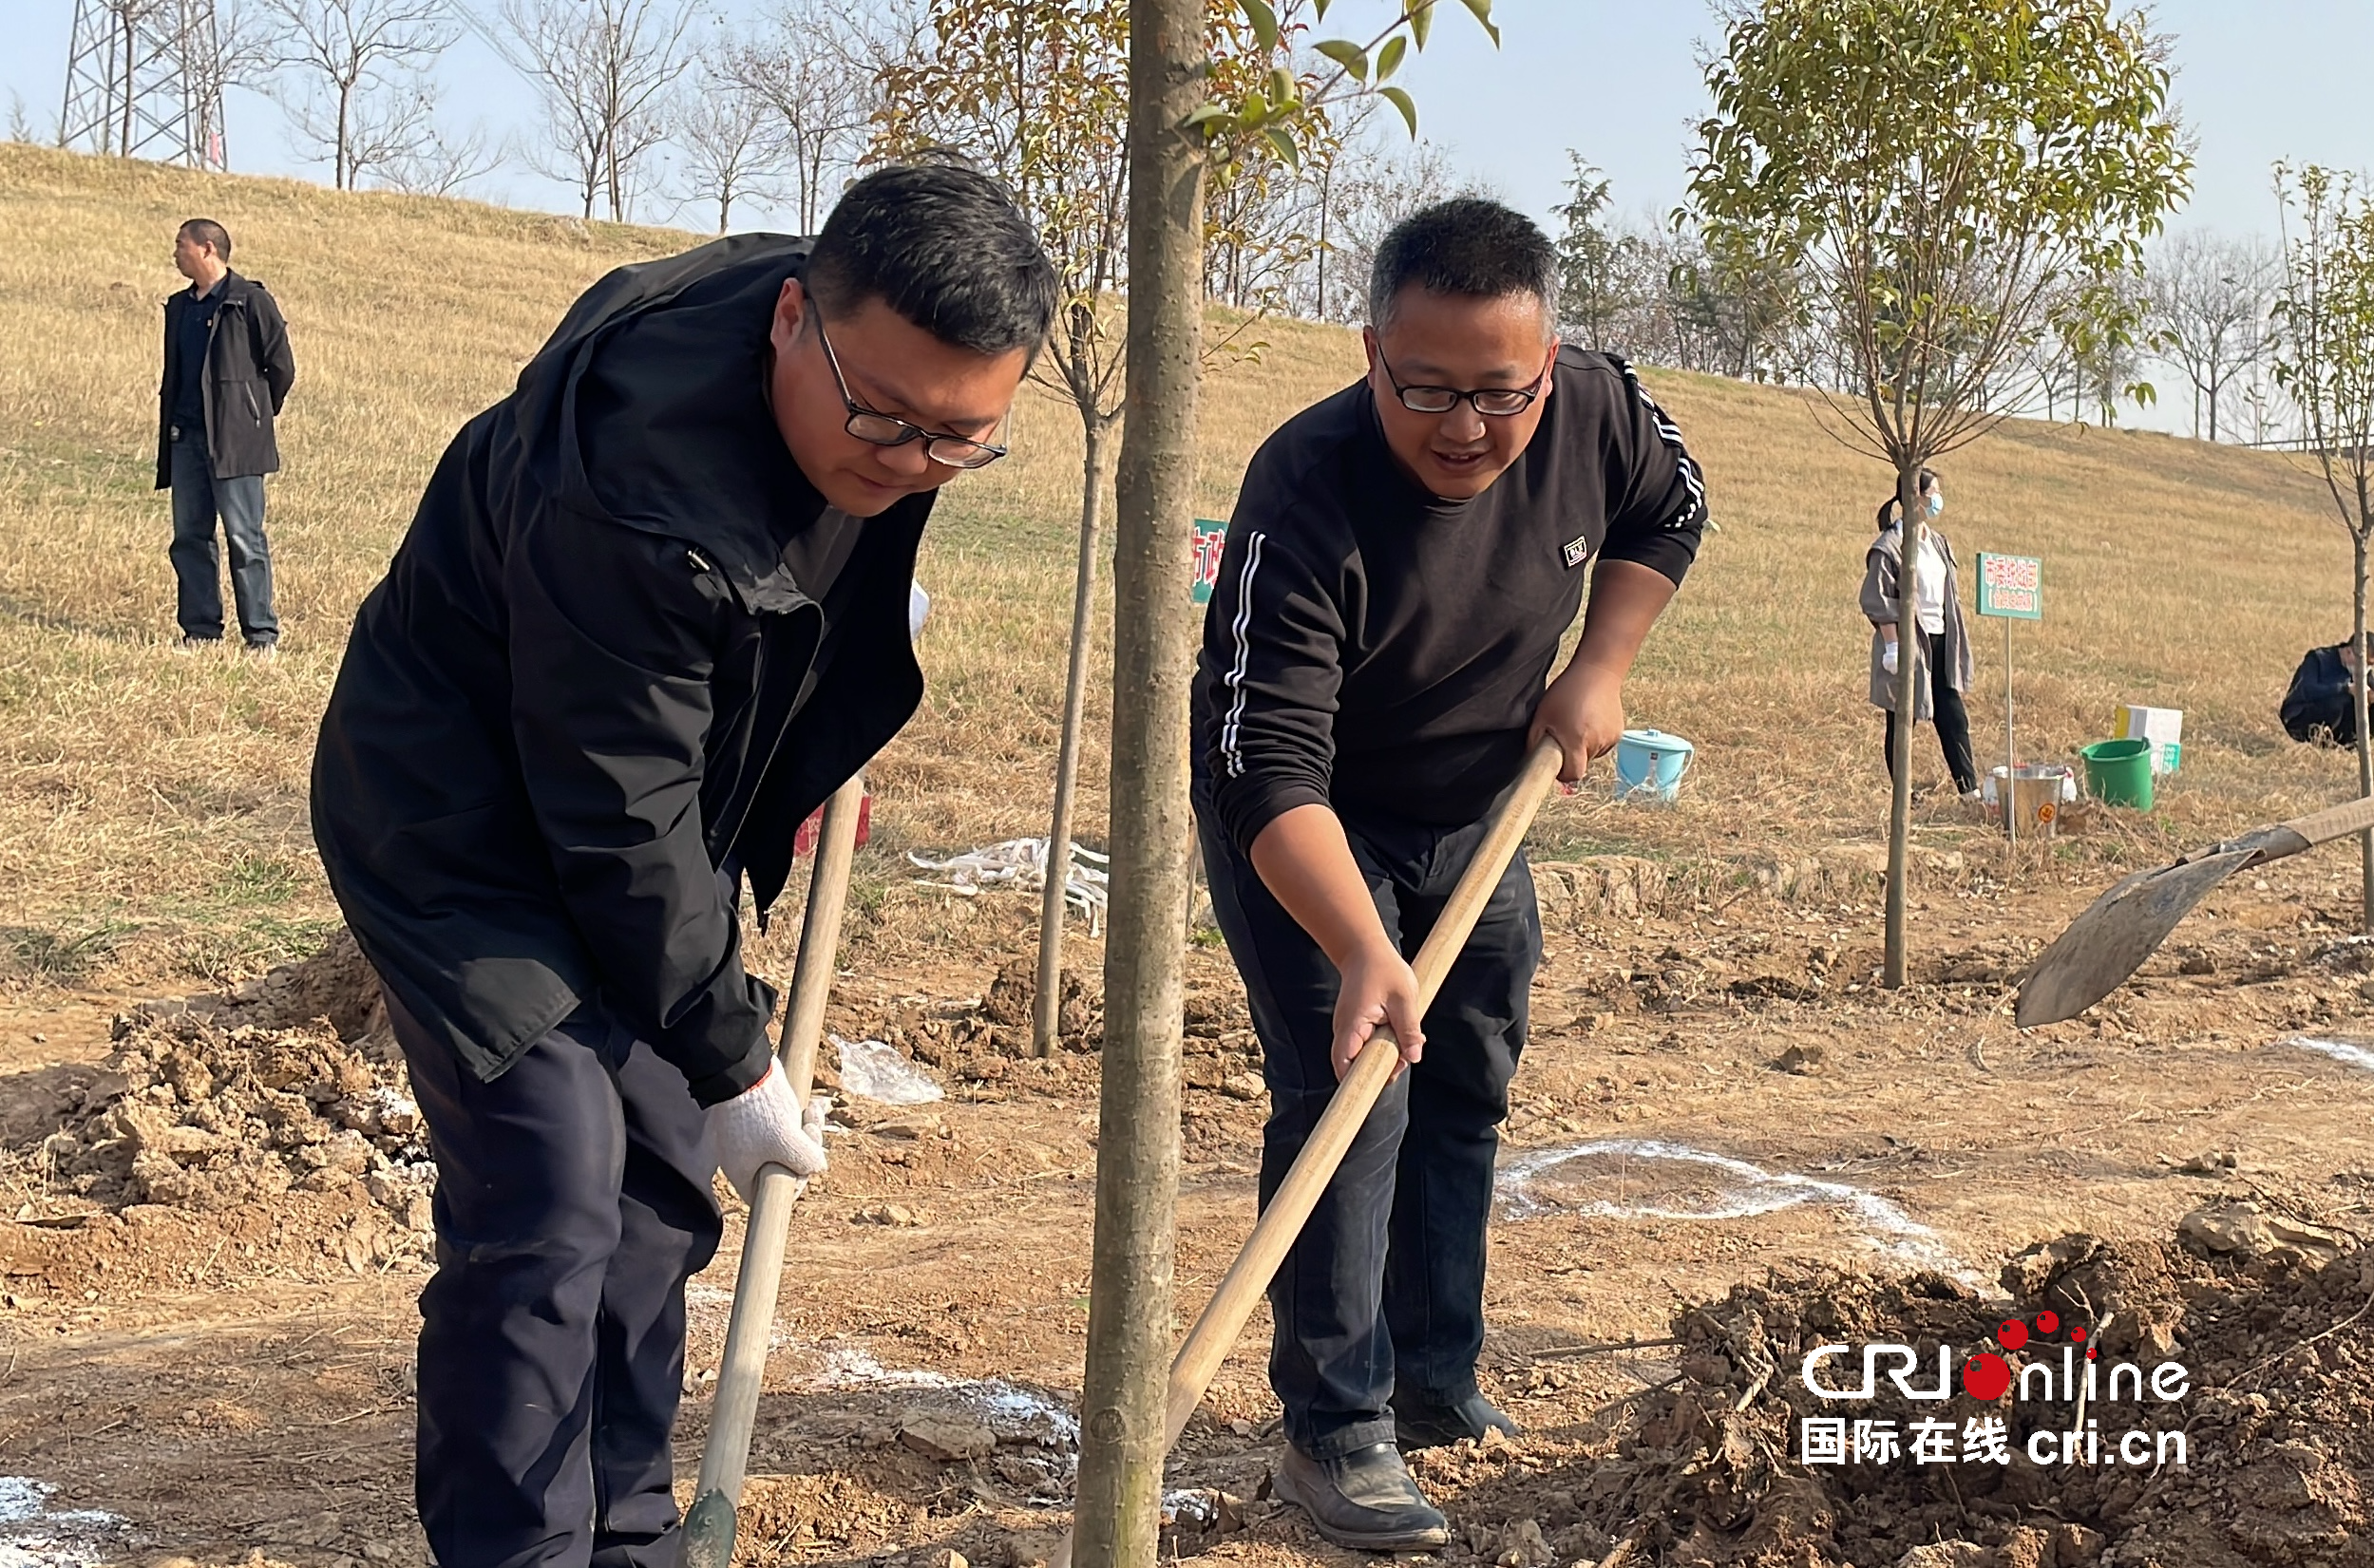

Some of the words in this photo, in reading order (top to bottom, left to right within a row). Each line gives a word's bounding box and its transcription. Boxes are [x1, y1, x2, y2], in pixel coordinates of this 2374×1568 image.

[1985, 555, 2038, 592] 市委统战部
